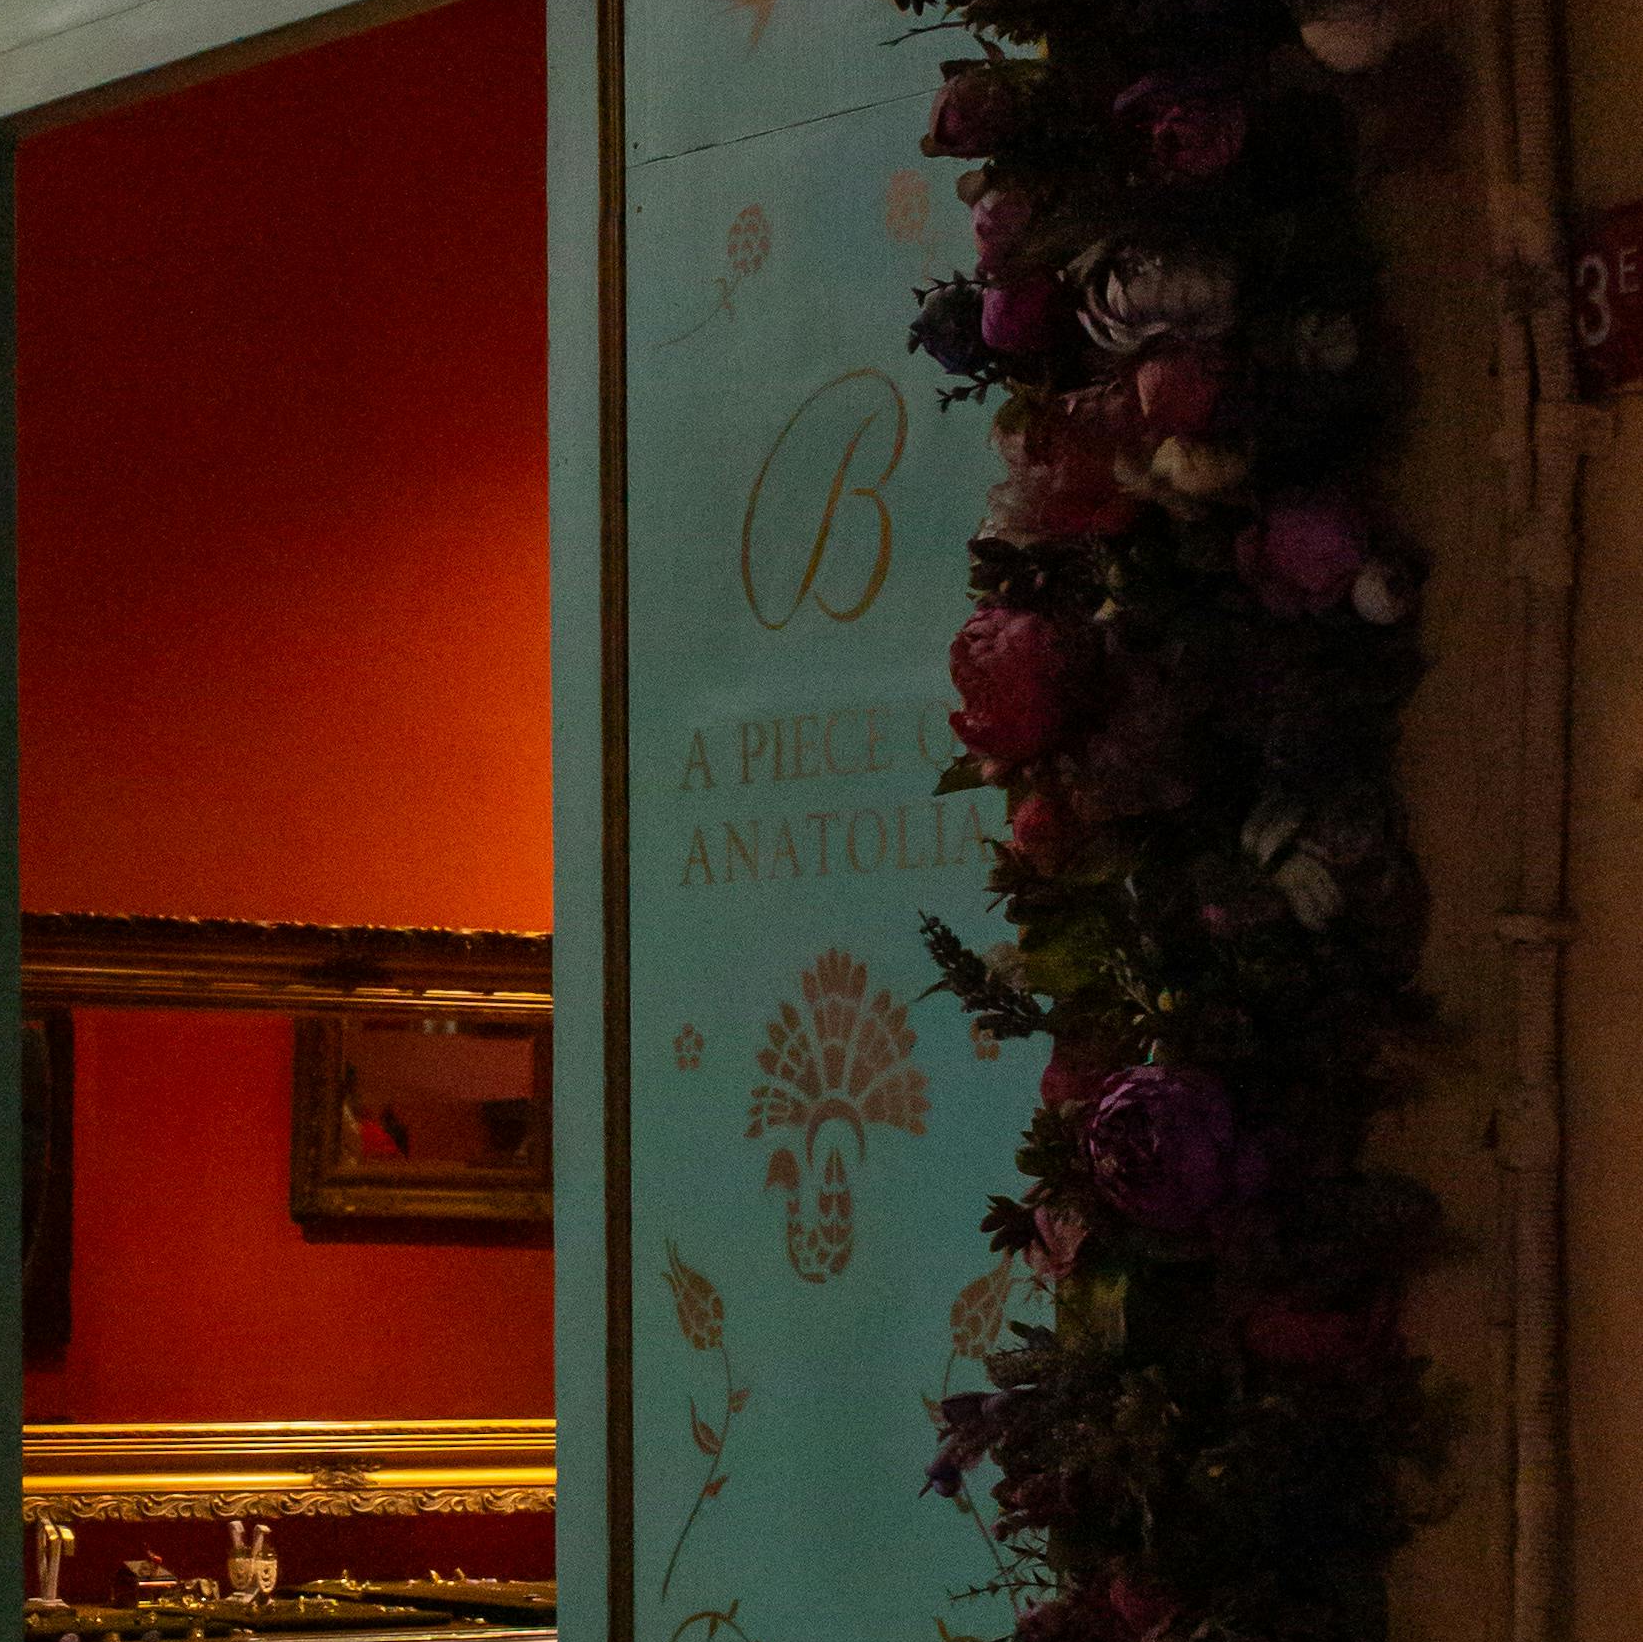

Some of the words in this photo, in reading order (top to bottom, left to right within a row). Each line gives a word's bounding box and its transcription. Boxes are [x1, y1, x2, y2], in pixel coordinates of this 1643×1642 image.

[741, 367, 909, 631] B
[678, 727, 716, 790] A
[737, 707, 894, 786] PIECE
[679, 801, 994, 886] ANATOLIA
